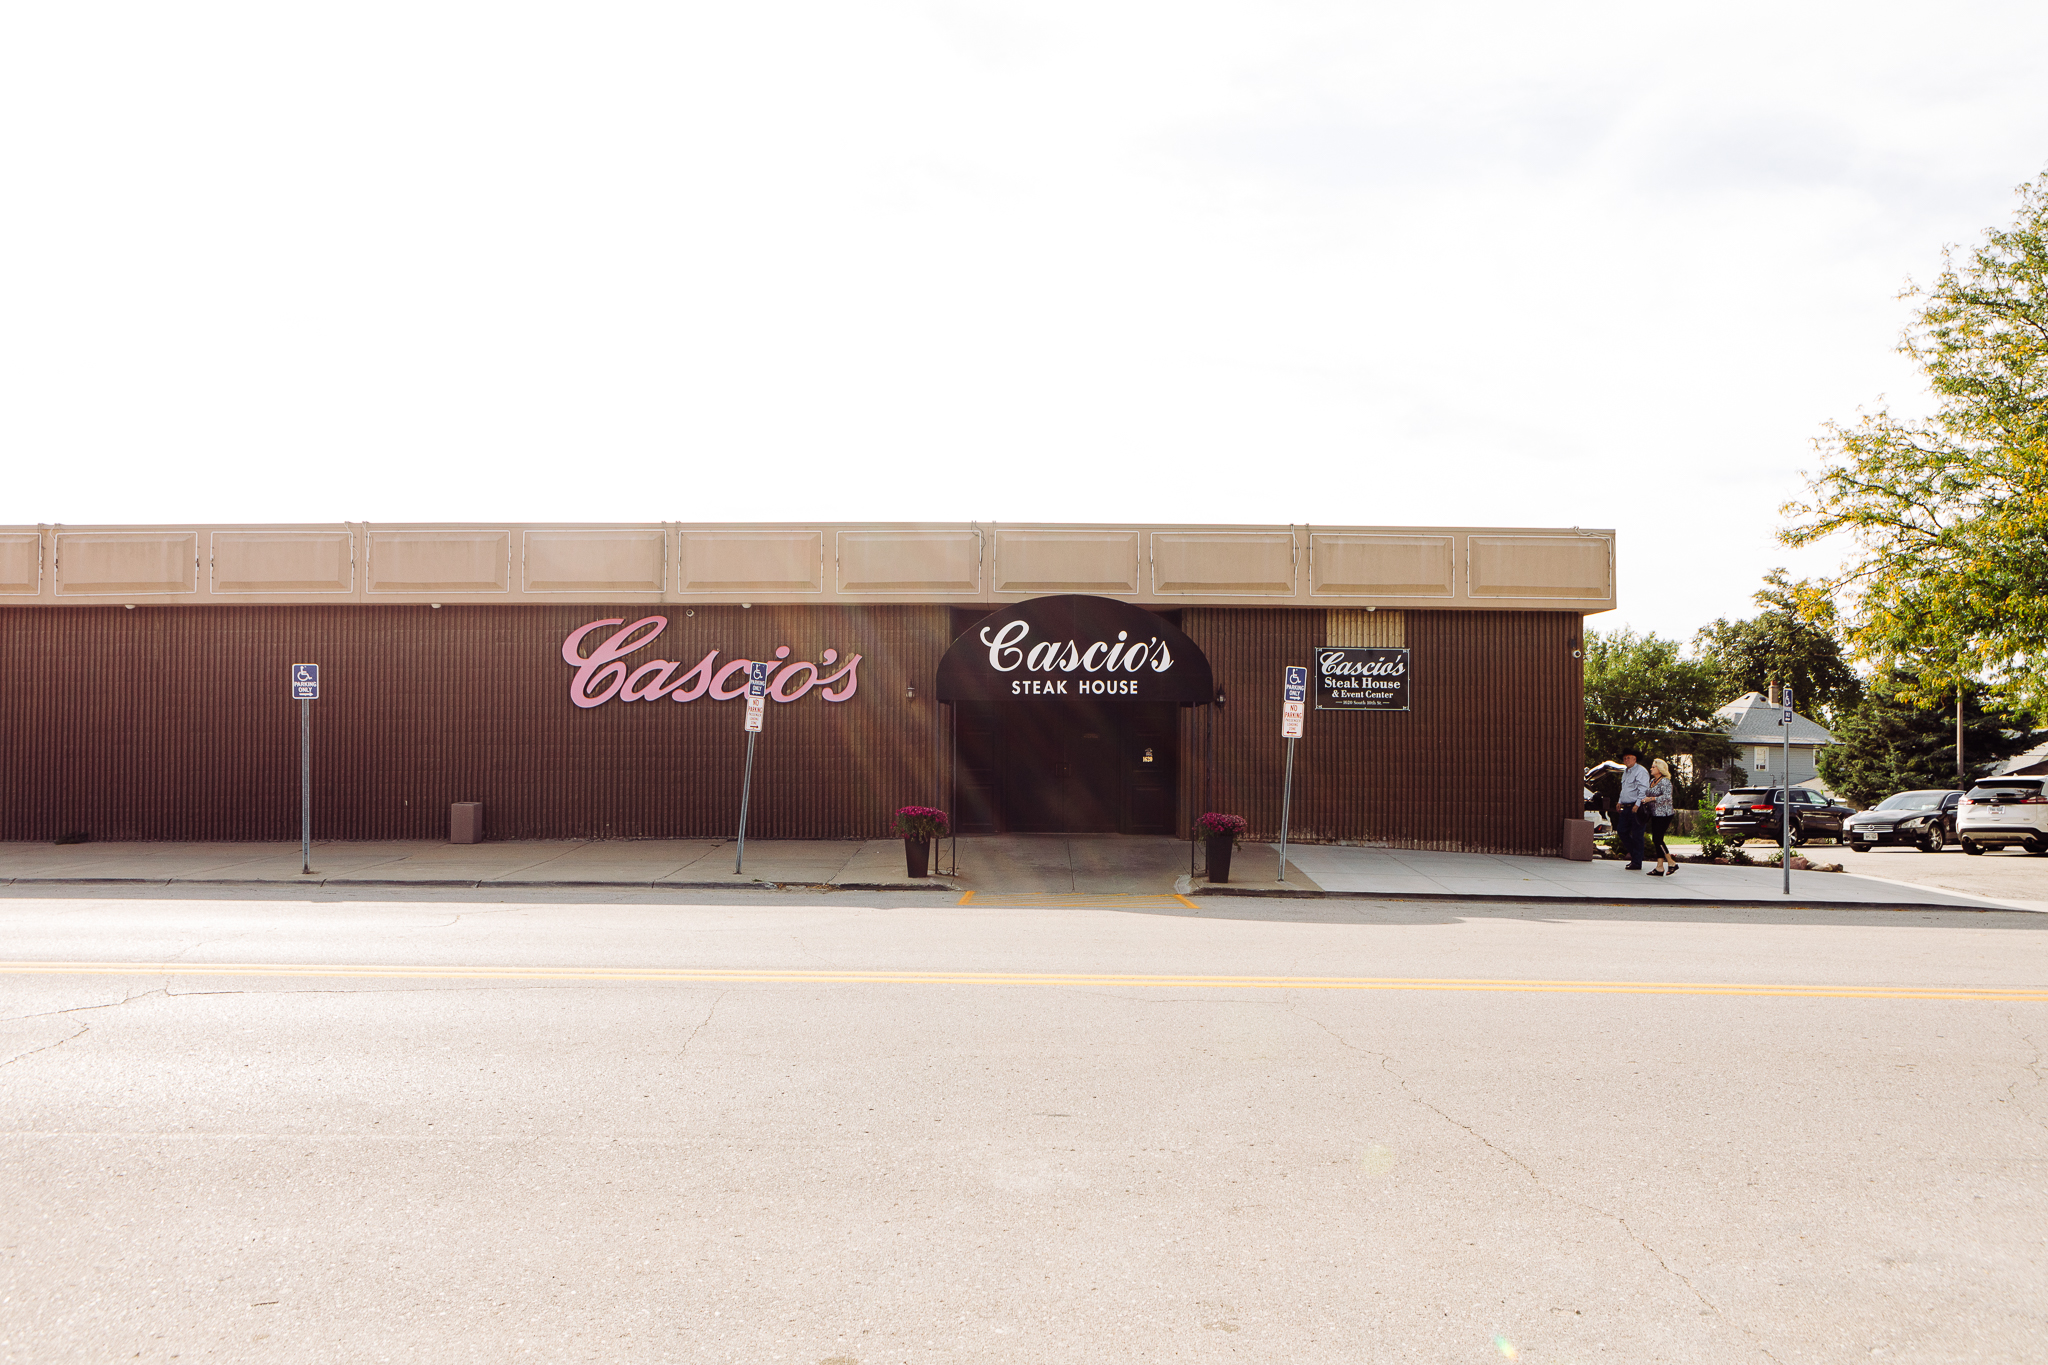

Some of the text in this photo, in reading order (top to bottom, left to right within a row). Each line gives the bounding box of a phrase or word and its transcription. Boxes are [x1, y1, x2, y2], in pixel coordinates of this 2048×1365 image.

[979, 619, 1175, 673] Cascio's
[561, 615, 863, 709] Cascio's
[1320, 652, 1406, 676] Cascio's
[1011, 680, 1139, 695] STEAK HOUSE
[1324, 677, 1401, 690] Steak House
[1331, 689, 1394, 699] & Event Center
[1284, 711, 1302, 719] PARKING
[1290, 704, 1298, 712] NO
